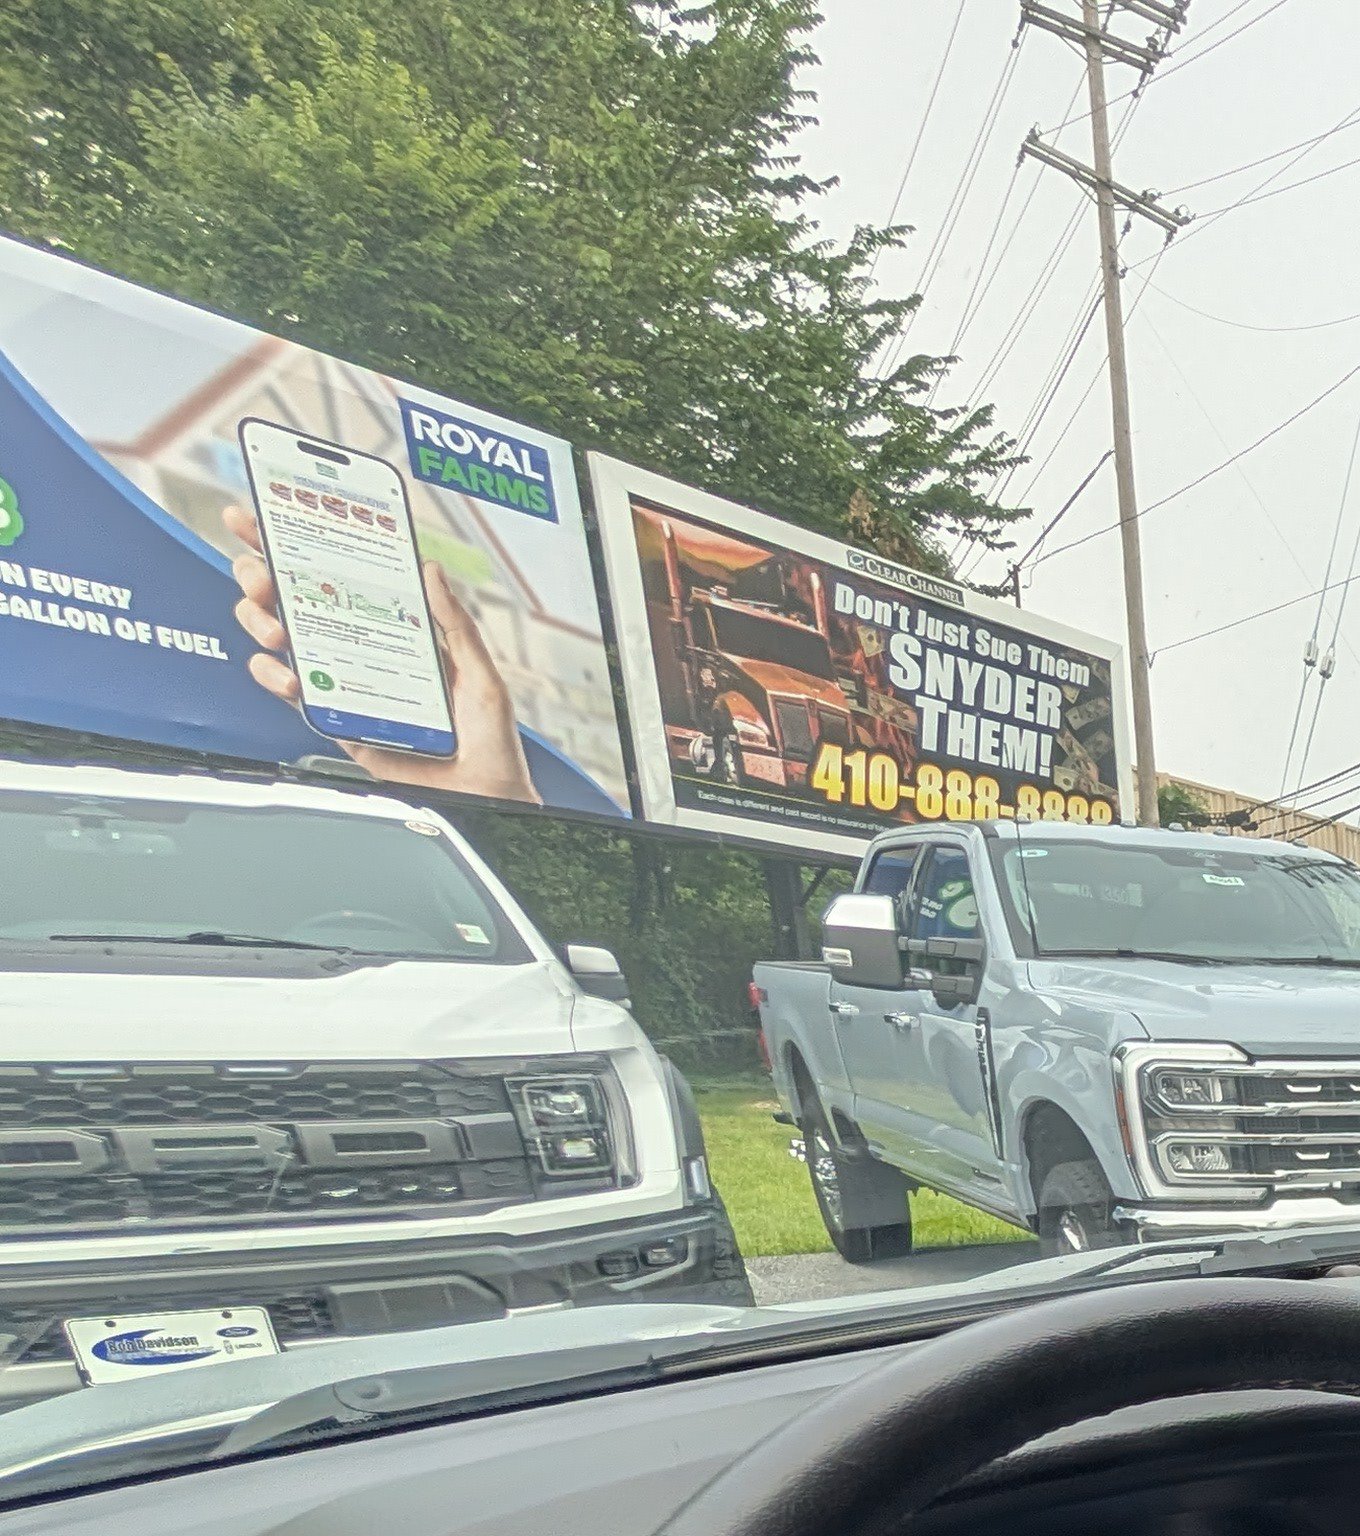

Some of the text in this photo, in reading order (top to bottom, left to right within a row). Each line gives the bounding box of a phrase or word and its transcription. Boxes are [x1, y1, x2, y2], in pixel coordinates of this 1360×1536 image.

[410, 410, 545, 482] ROYAL
[418, 446, 550, 514] FARMS
[29, 567, 132, 610] EVERY
[114, 617, 152, 645] OF
[156, 625, 229, 660] FUEL
[834, 583, 1091, 687] Don't Just Sue Them
[889, 632, 1062, 729] SNYDER
[915, 695, 1053, 777] THEM!
[812, 742, 1113, 825] 410-888-8888
[138, 1335, 198, 1350] Davidson
